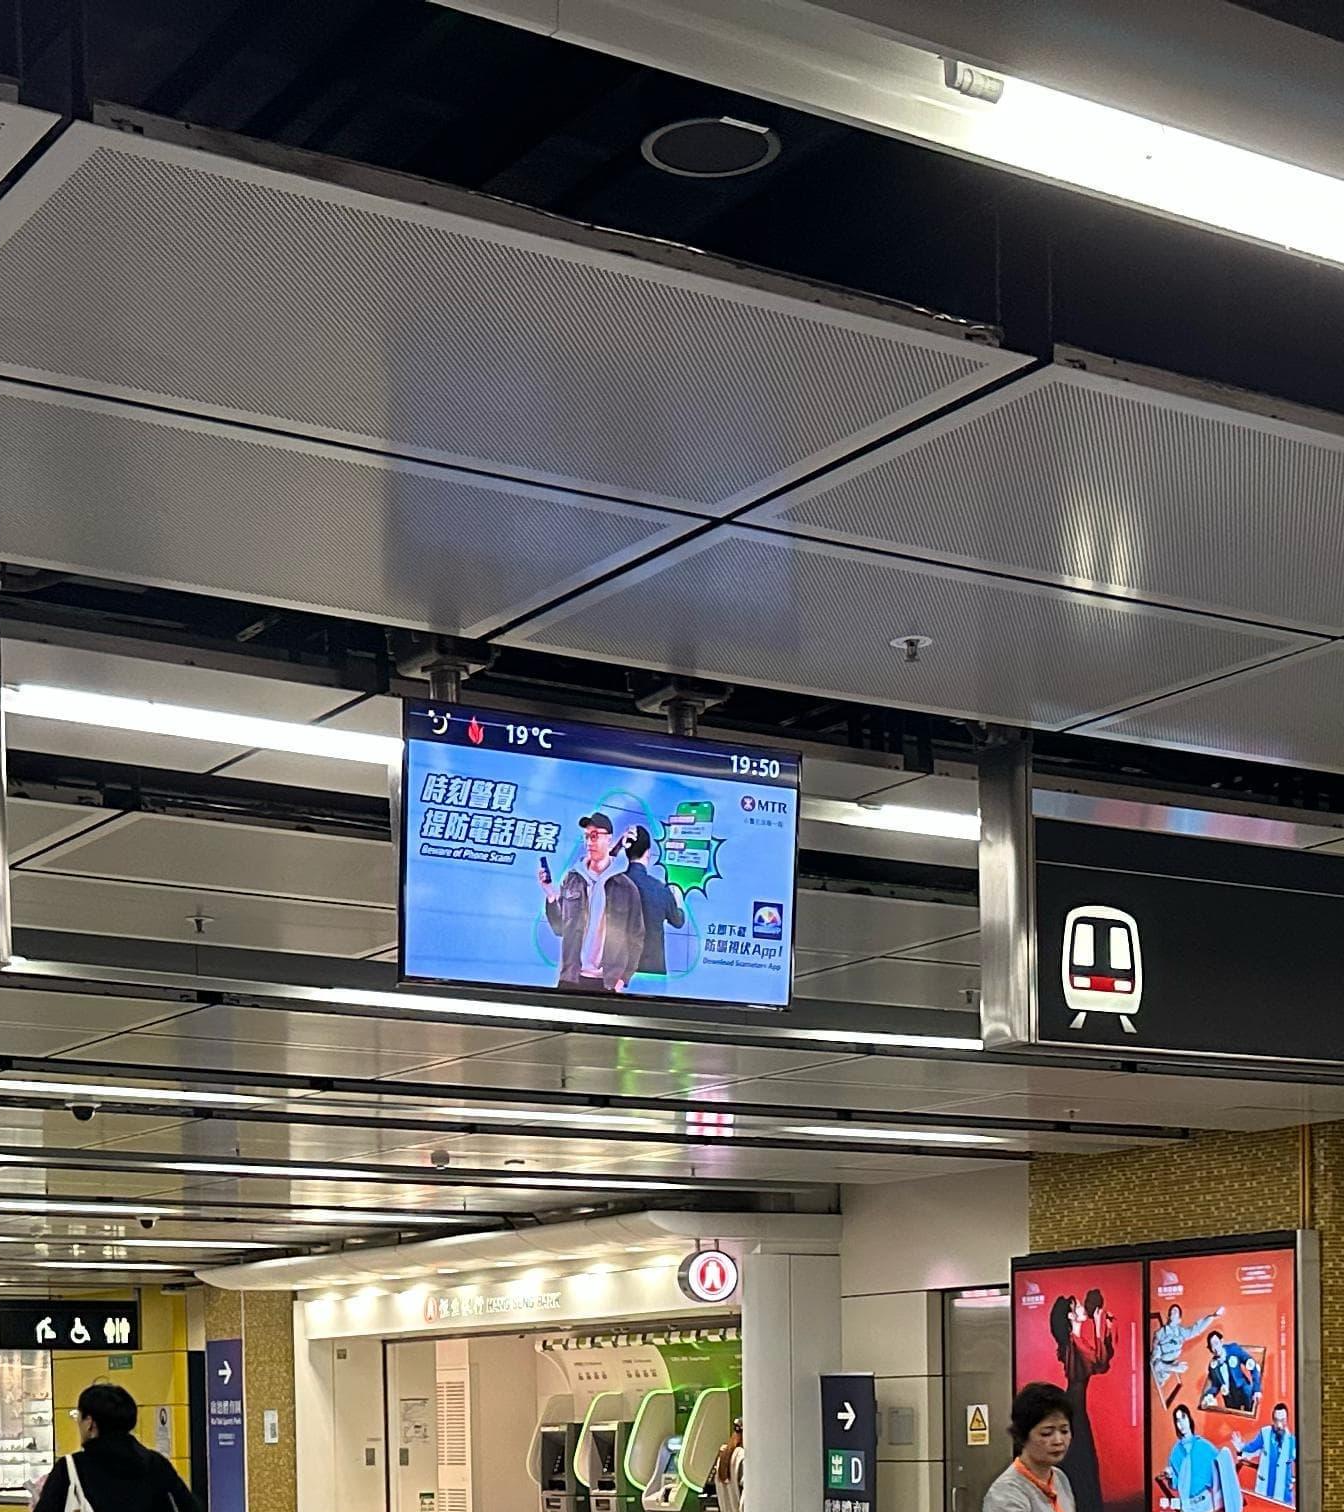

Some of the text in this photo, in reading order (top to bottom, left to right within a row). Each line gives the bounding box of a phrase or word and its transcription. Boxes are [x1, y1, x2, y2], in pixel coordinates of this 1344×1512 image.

[506, 724, 552, 749] 19°C
[730, 755, 780, 778] 19:50
[422, 774, 517, 812] 時刻警覺
[757, 800, 787, 814] MTR
[422, 809, 559, 851] 提防電話騙案
[850, 1456, 863, 1484] D
